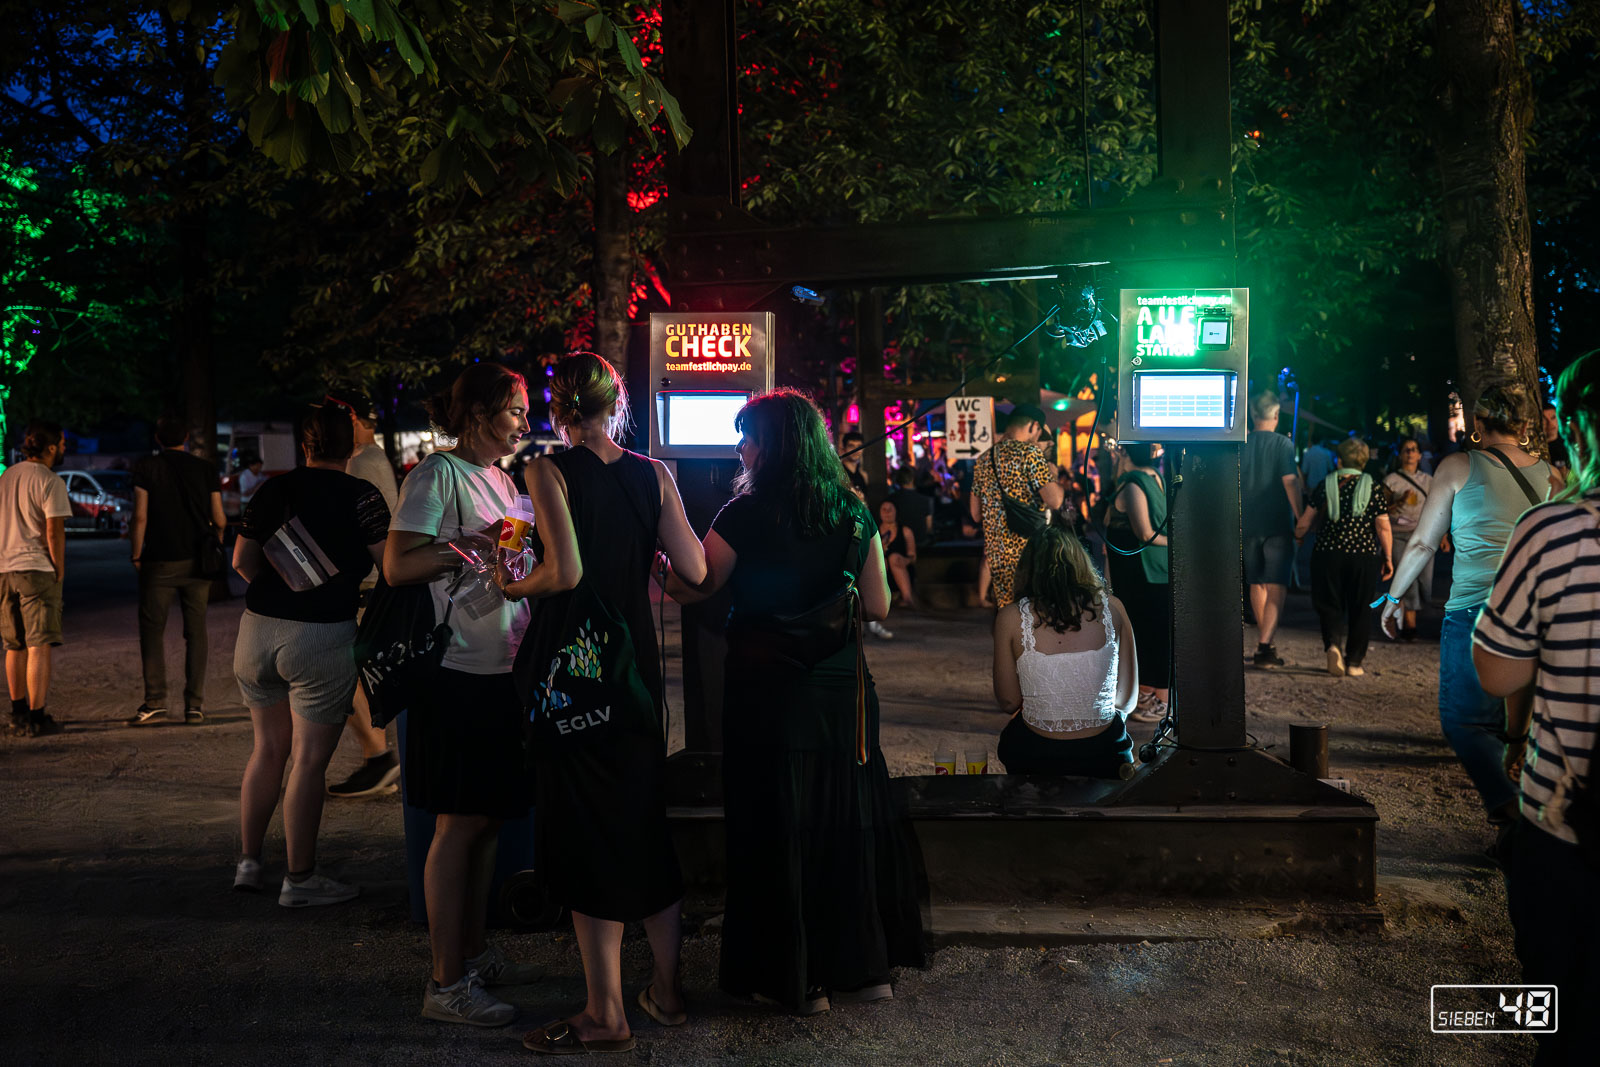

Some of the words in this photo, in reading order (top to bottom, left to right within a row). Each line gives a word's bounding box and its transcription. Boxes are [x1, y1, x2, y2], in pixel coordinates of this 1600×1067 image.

[665, 323, 752, 336] GUTHABEN
[1137, 325, 1195, 343] LA
[665, 335, 752, 358] CHECK
[1136, 343, 1195, 356] STATION
[665, 361, 752, 373] teamfestlichpay.de
[955, 399, 981, 411] WC
[555, 705, 611, 735] EGLV
